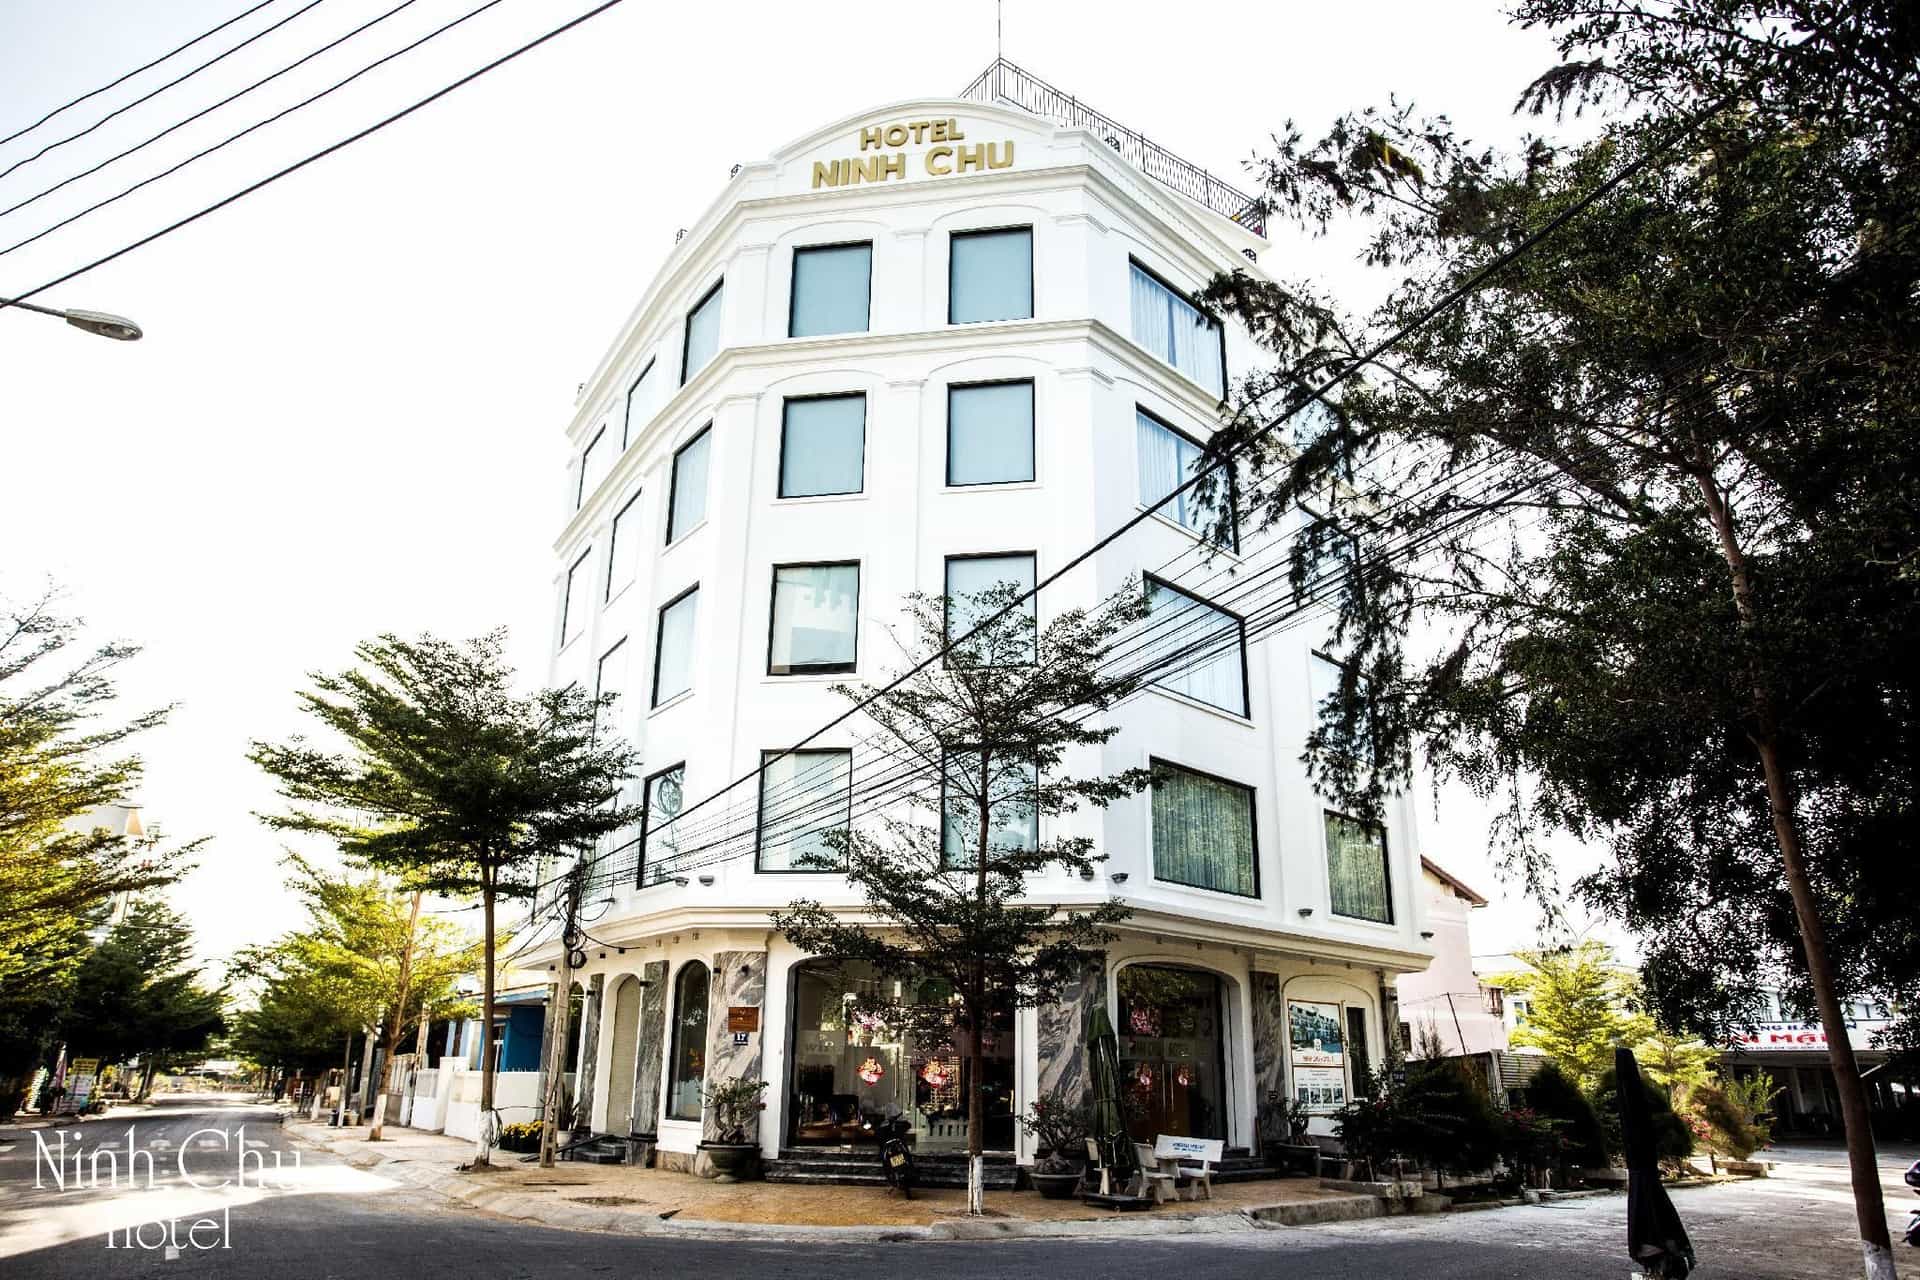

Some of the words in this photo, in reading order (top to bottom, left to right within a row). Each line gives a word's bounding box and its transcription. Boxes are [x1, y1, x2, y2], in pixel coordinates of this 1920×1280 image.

[860, 118, 964, 151] HOTEL
[811, 153, 906, 189] NINH
[925, 140, 1015, 176] CHU
